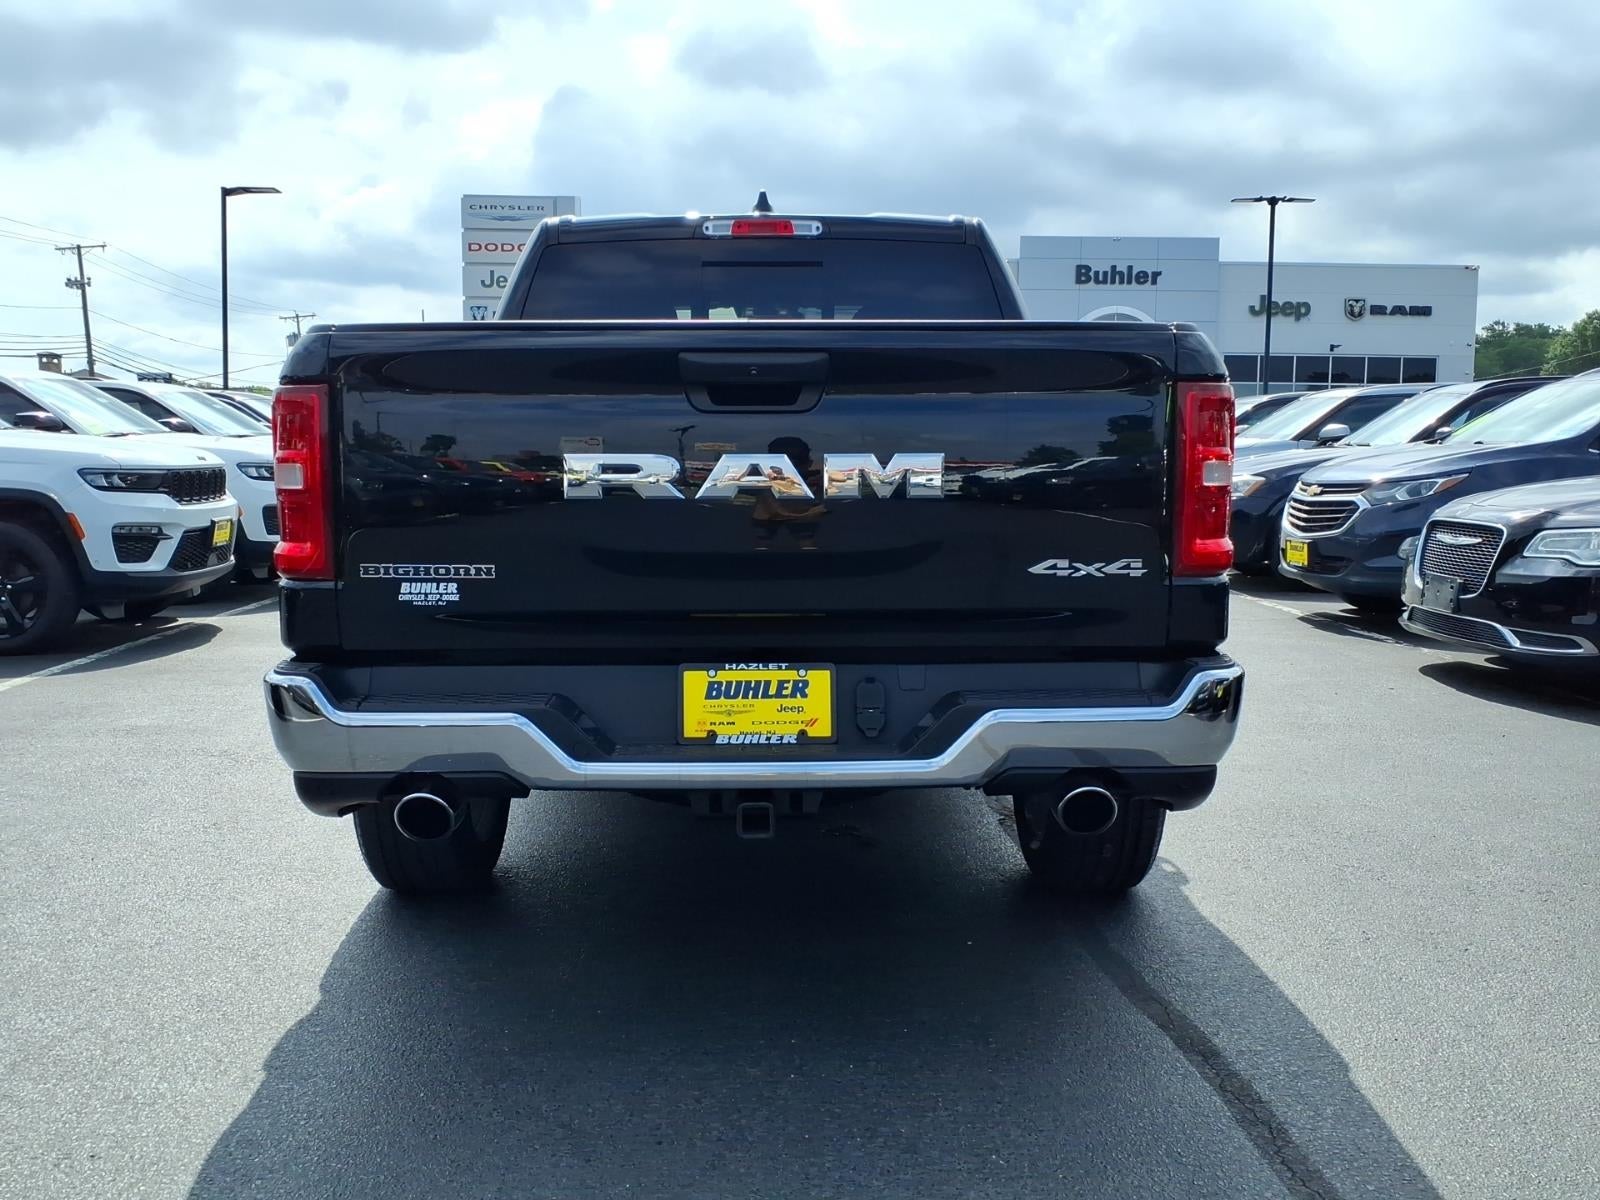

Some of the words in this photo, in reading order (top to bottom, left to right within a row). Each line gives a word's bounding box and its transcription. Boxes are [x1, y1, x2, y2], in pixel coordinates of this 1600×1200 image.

[467, 242, 526, 252] DOD
[480, 269, 508, 289] Je
[1075, 264, 1162, 285] Buhler
[1248, 294, 1311, 322] Jeep
[1370, 304, 1432, 316] RAM
[563, 453, 945, 499] RAM
[359, 563, 496, 579] BIGHORN
[400, 582, 458, 594] BUHLER
[704, 679, 810, 700] BUHLER
[776, 704, 804, 714] Jeep
[715, 734, 798, 744] BUHLER
